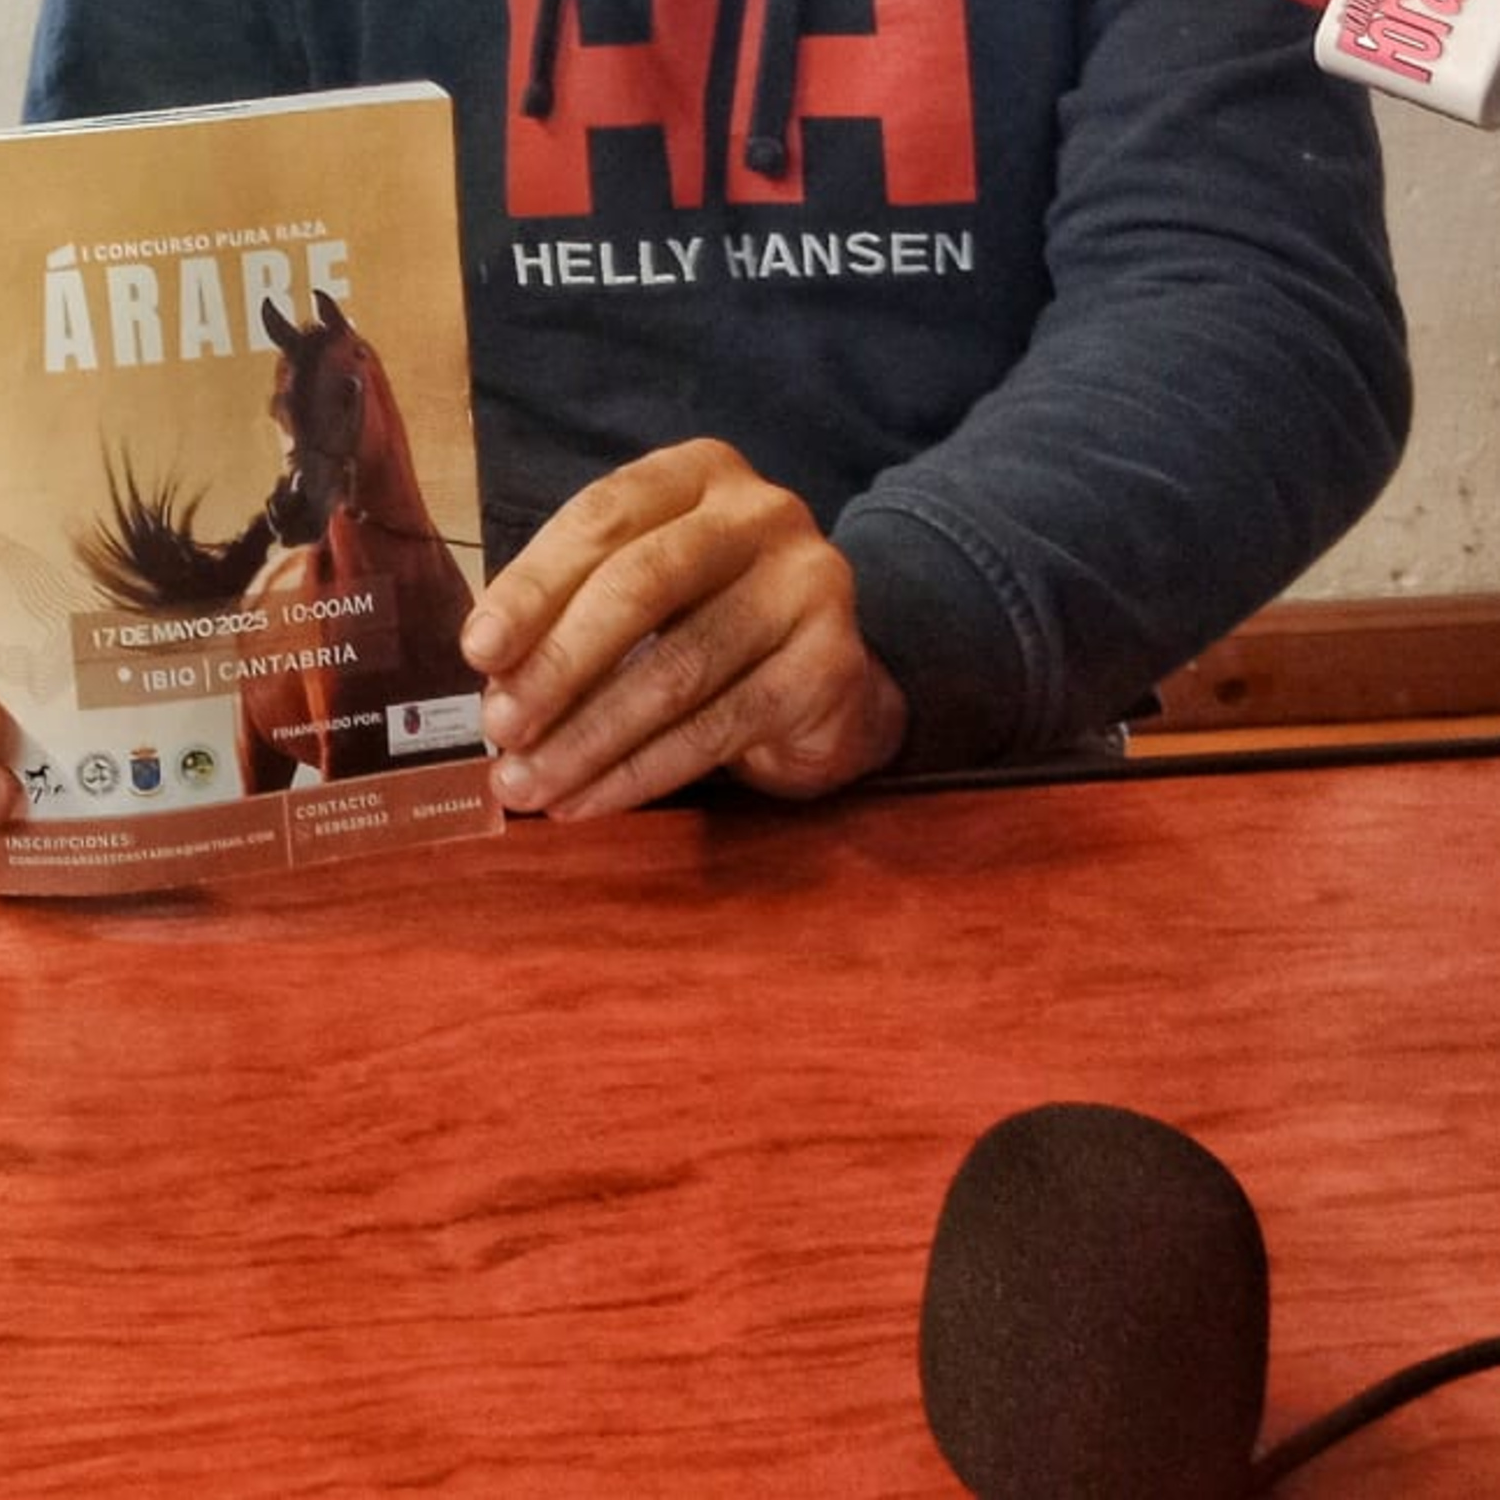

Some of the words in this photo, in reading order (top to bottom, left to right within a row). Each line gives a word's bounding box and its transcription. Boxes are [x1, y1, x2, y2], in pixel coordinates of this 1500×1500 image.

[94, 234, 210, 261] CONCURSO
[215, 226, 270, 249] PURA
[276, 220, 327, 241] RAZA
[513, 237, 702, 286] HELLY
[724, 231, 974, 279] HANSEN
[93, 626, 118, 649] 17
[119, 624, 151, 647] DE
[152, 617, 213, 645] MAYO
[214, 610, 269, 636] 2025
[142, 666, 197, 692] IBIO
[217, 643, 359, 681] CANTABRIA
